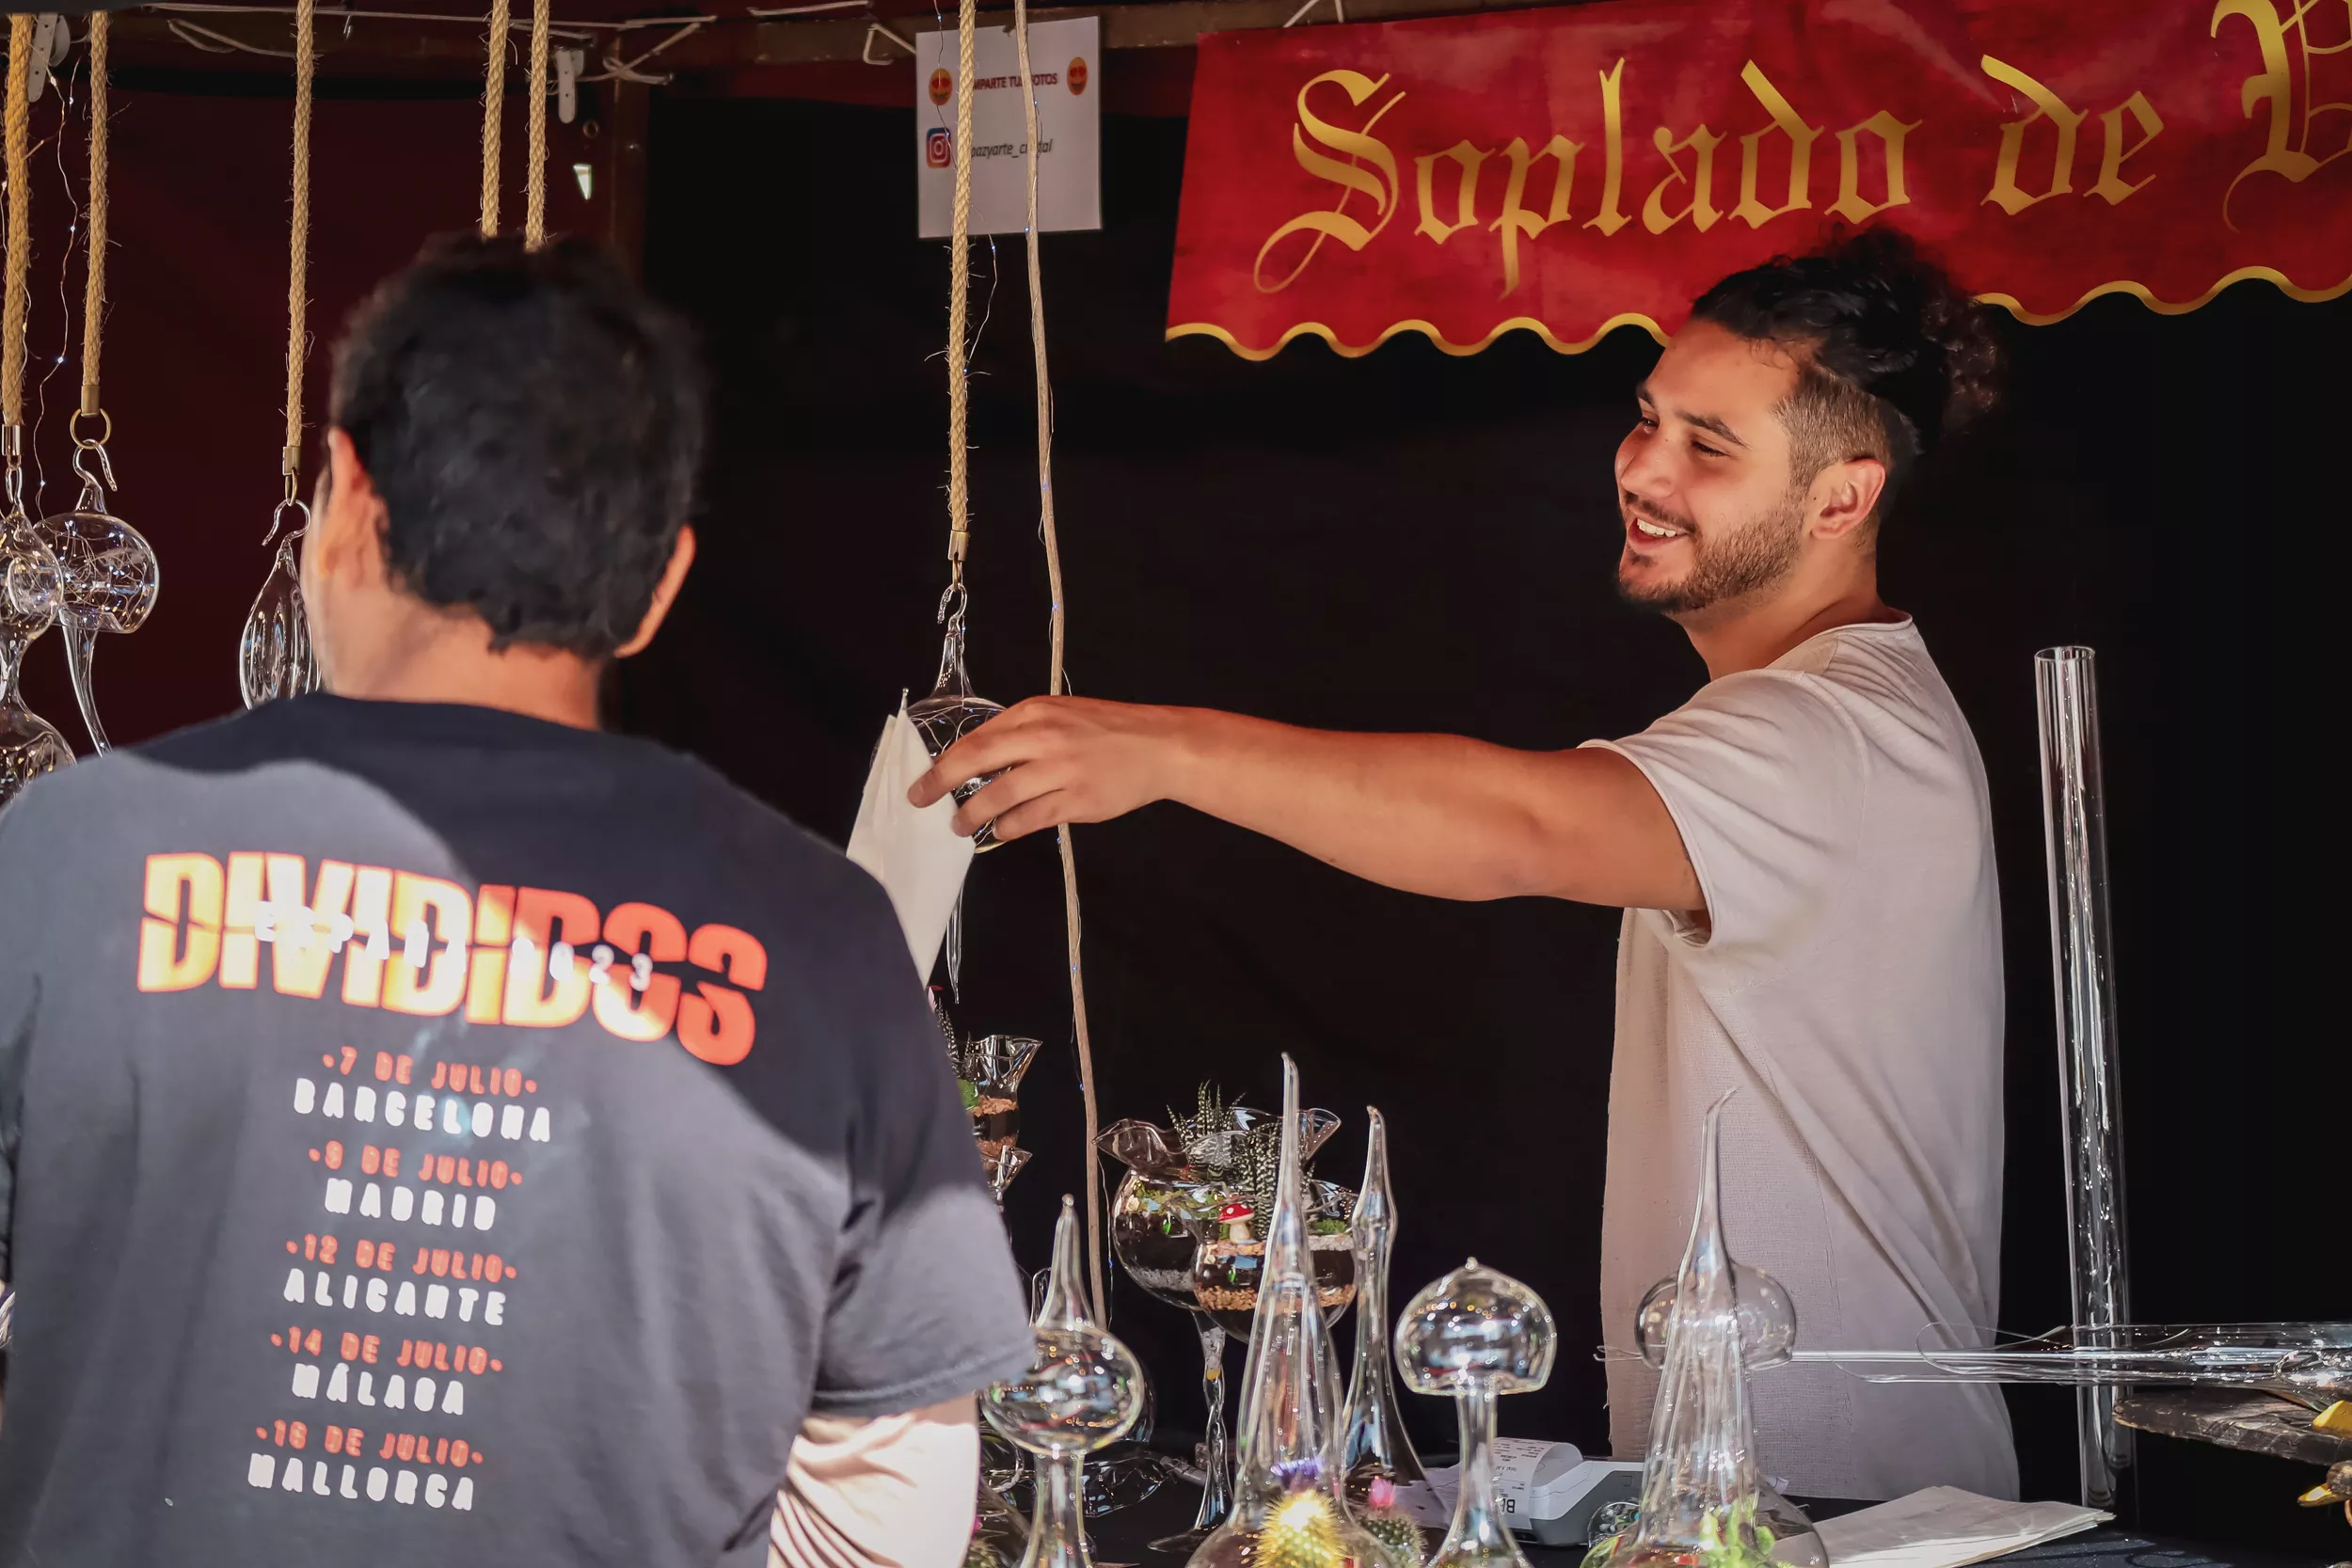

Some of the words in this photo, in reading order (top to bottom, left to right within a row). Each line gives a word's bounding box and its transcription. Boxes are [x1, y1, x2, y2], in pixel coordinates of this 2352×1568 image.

[1252, 56, 1924, 300] Soplado
[1980, 53, 2169, 218] de
[136, 850, 769, 1066] DIVIDIDOS
[373, 1051, 414, 1085] DE
[430, 1061, 523, 1098] JULIO
[293, 1078, 551, 1143] BARCELONA
[360, 1145, 401, 1179] DE
[418, 1154, 509, 1190] JULIO
[325, 1178, 497, 1231] MADRID
[355, 1239, 396, 1272] DE
[412, 1247, 503, 1284] JULIO
[283, 1268, 506, 1326] ALICANTE
[340, 1331, 381, 1368] DE
[396, 1338, 488, 1376] JULIO
[324, 1425, 365, 1457] DE
[378, 1433, 470, 1468] JULIO
[247, 1453, 474, 1511] MALLORCA
